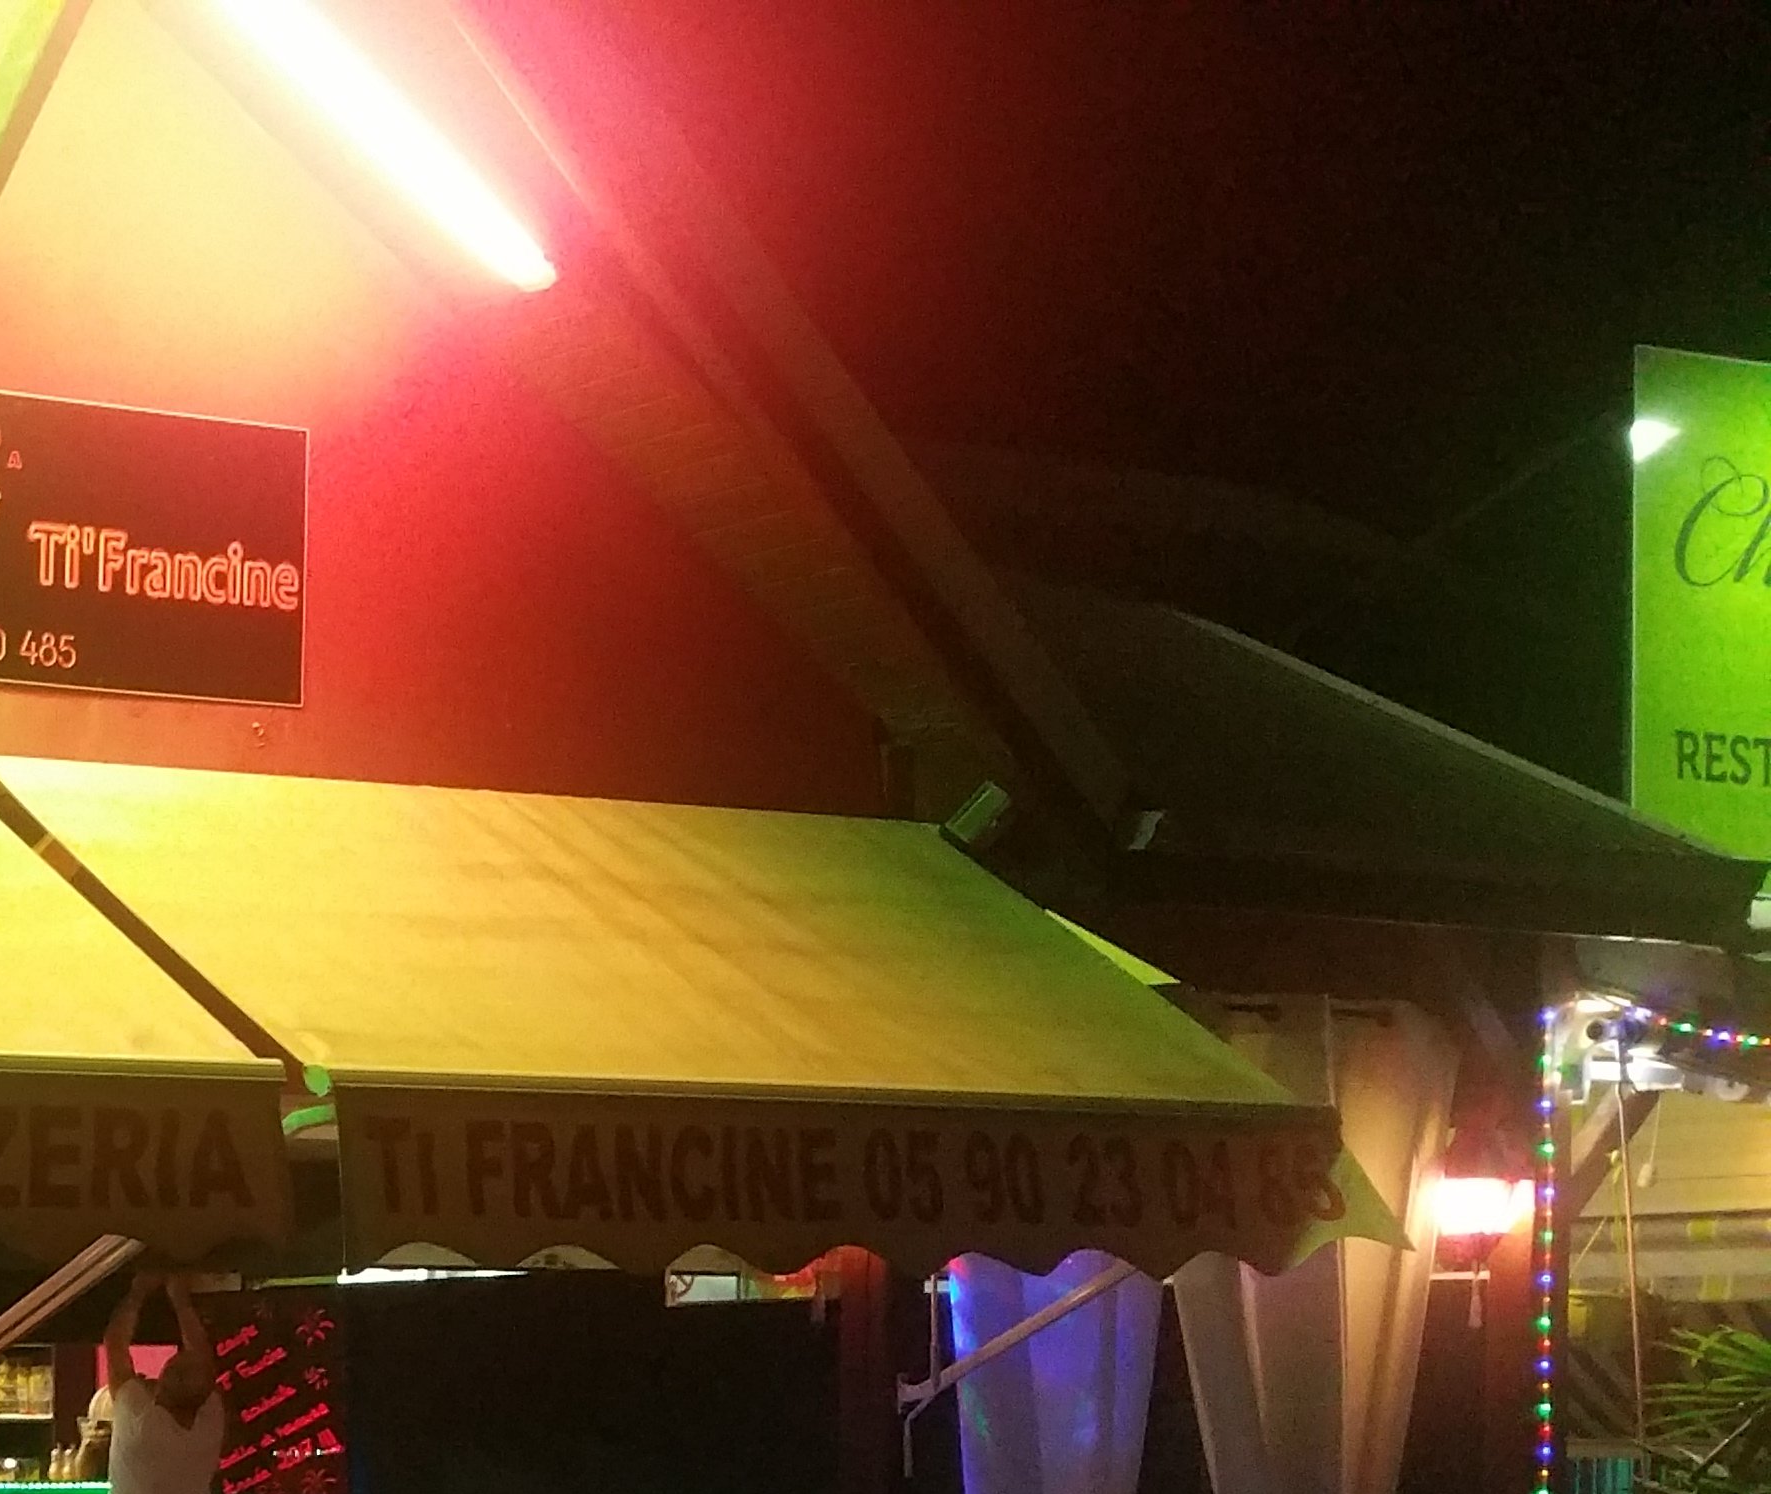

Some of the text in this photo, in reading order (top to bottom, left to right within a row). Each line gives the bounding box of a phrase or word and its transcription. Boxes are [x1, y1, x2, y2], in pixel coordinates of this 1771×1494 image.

[27, 522, 300, 611] Ti'Francine
[19, 630, 78, 669] 485
[366, 1115, 441, 1216] TI
[465, 1120, 843, 1223] FRANCINE
[862, 1127, 944, 1224] 05
[965, 1129, 1044, 1226] 90
[1068, 1131, 1146, 1228] 23
[1160, 1137, 1237, 1231] 04
